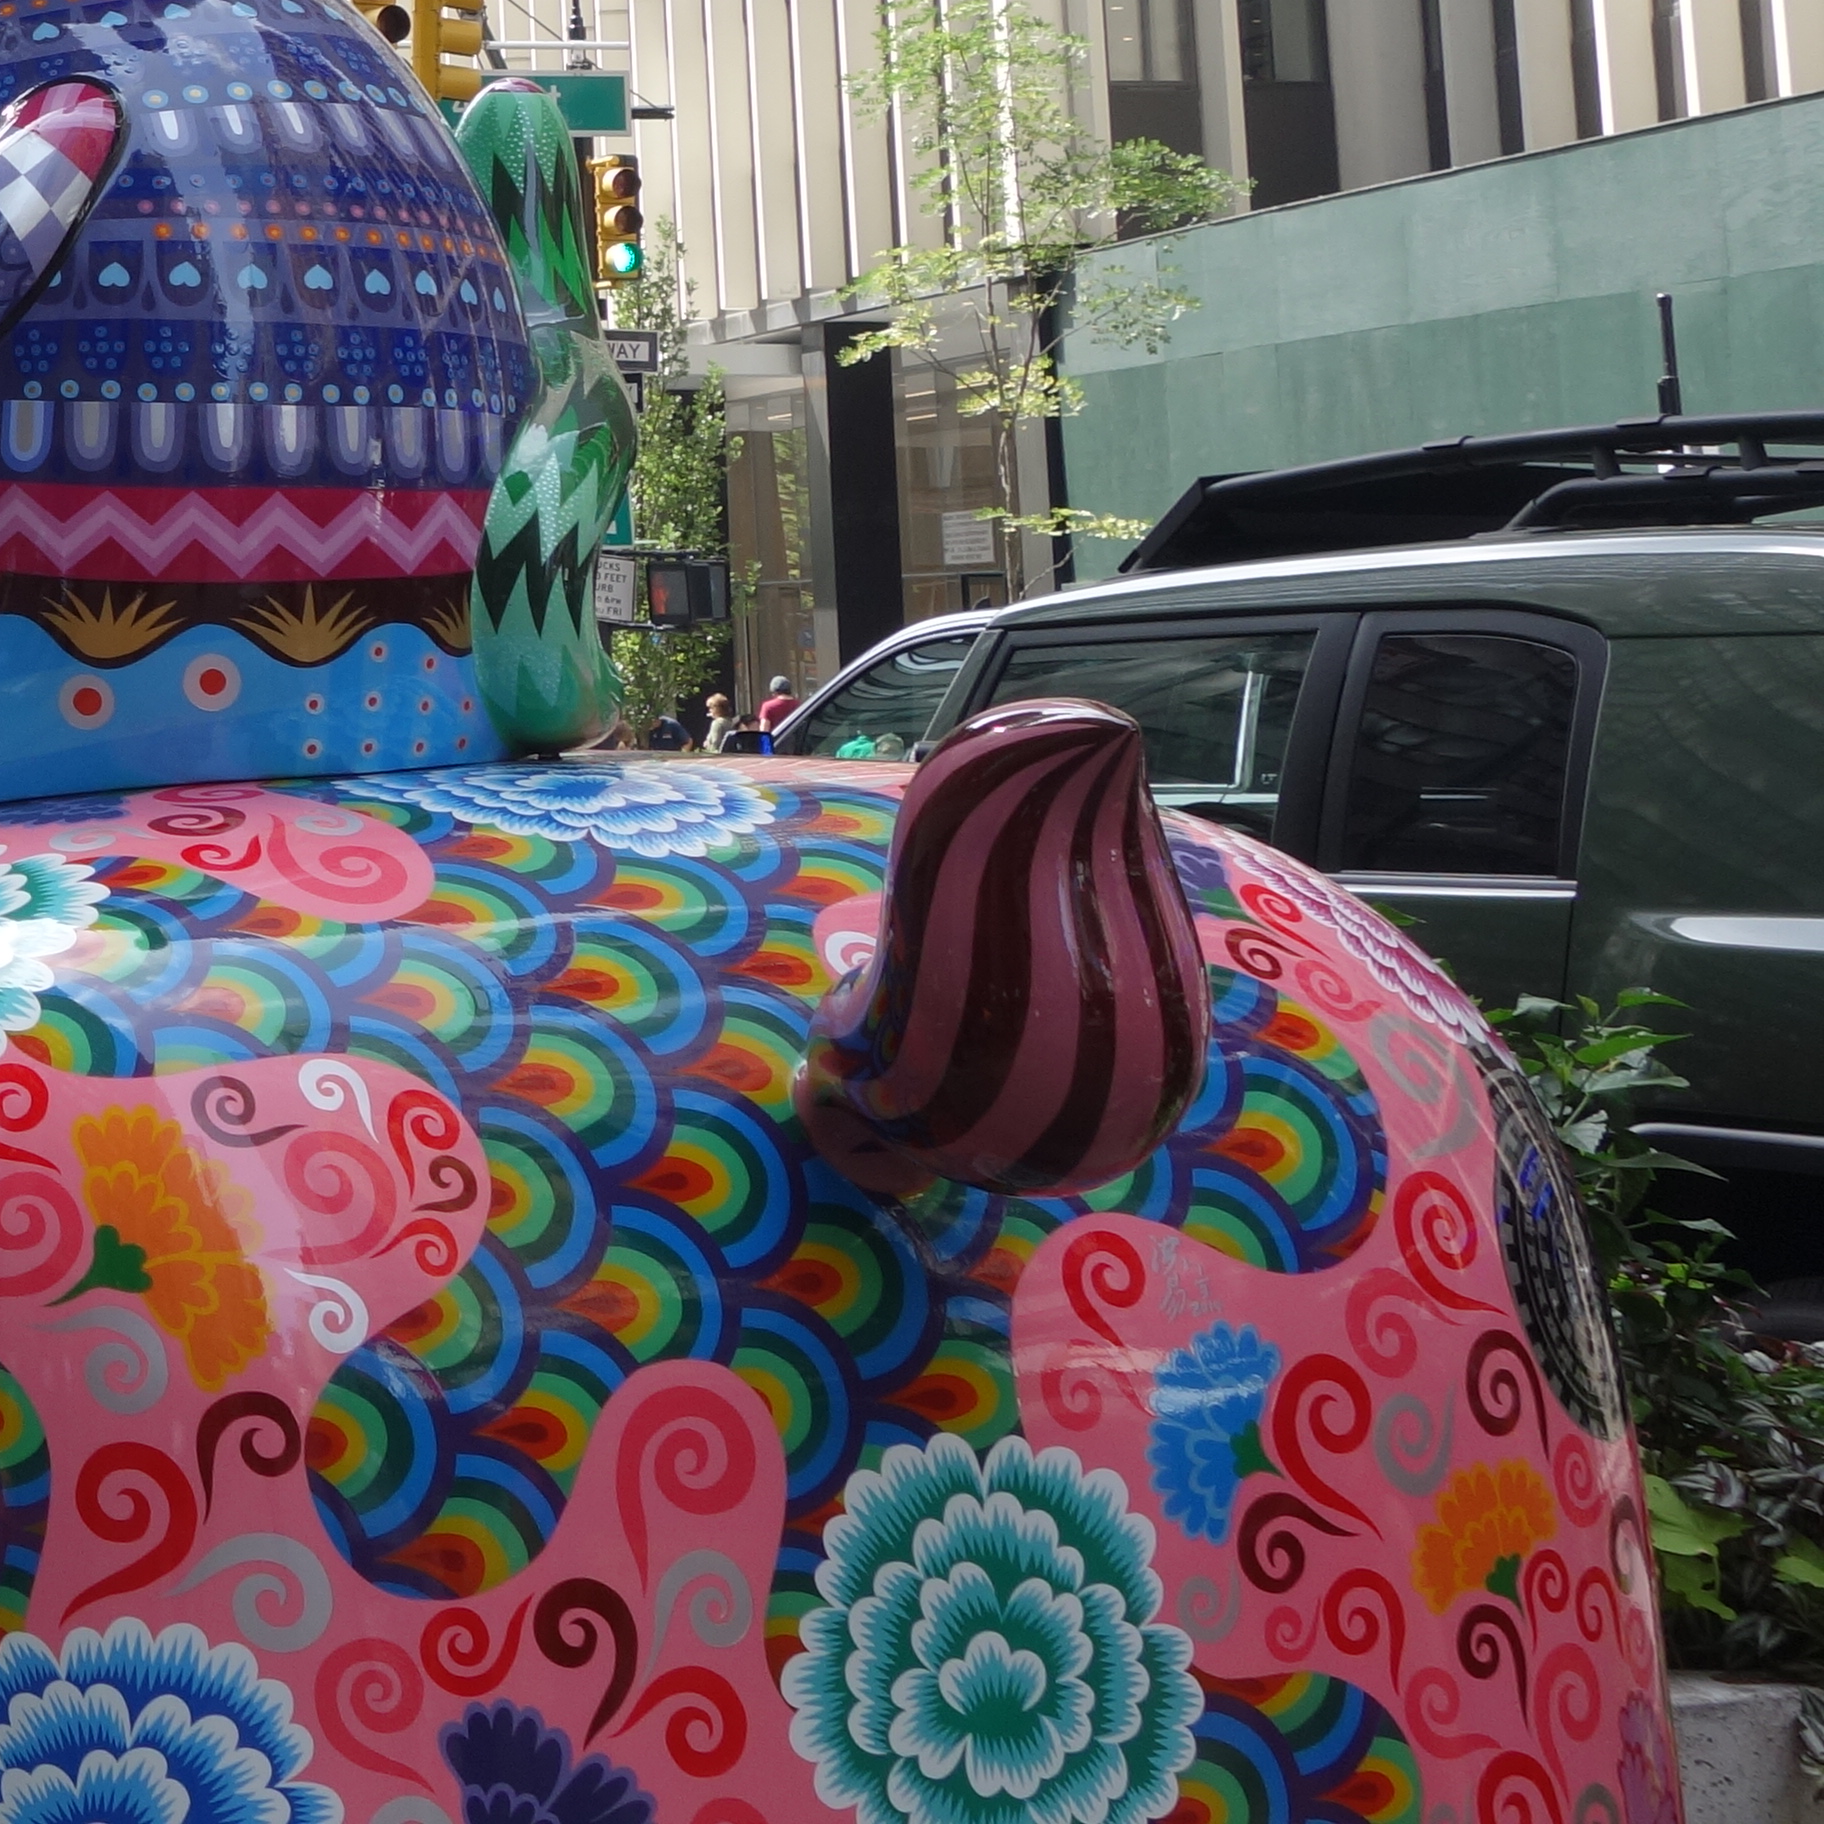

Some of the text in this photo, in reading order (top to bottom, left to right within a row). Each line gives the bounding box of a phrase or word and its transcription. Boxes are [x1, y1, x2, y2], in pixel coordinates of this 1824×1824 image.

[597, 562, 620, 572] UCKS
[604, 573, 627, 583] FEET
[596, 584, 614, 593] URB
